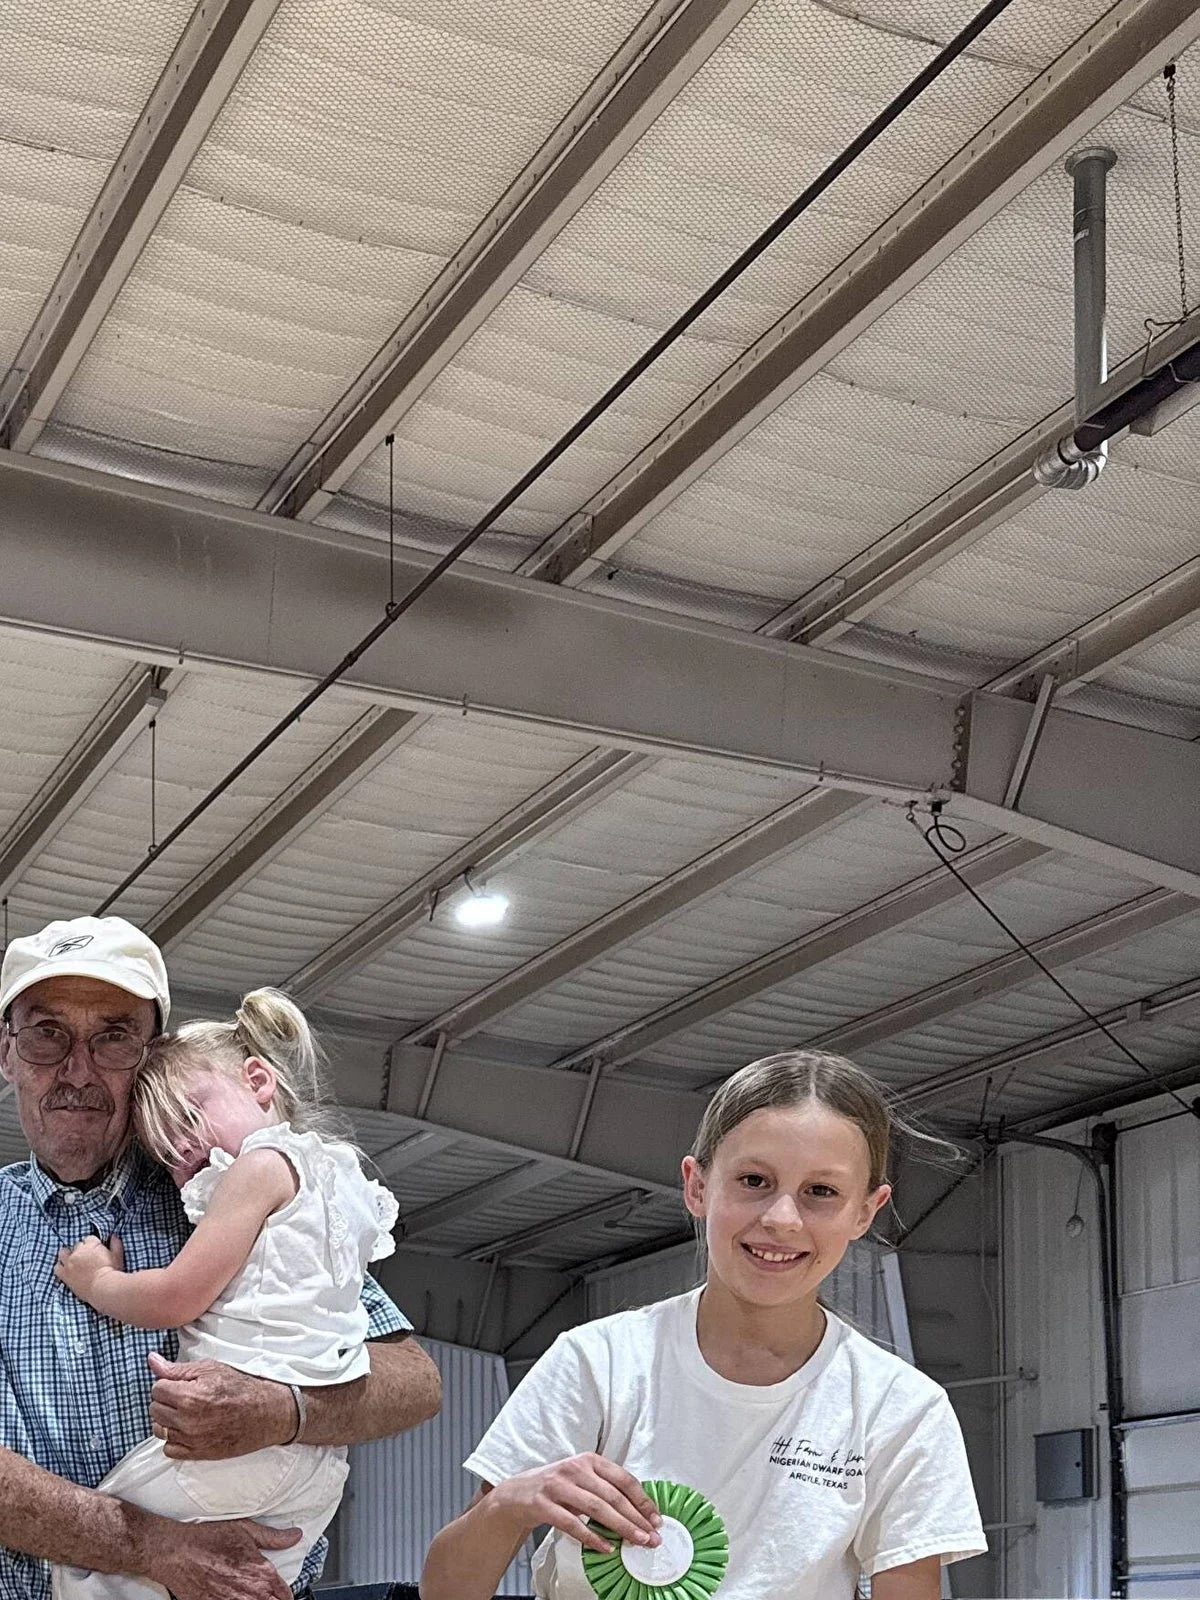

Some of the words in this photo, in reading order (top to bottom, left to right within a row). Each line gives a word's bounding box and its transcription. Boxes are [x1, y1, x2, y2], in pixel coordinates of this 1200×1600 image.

[769, 1455, 811, 1468] NIGERIAN
[812, 1463, 844, 1476] DWARF
[845, 1467, 864, 1477] GOA
[822, 1478, 849, 1490] TEXAS
